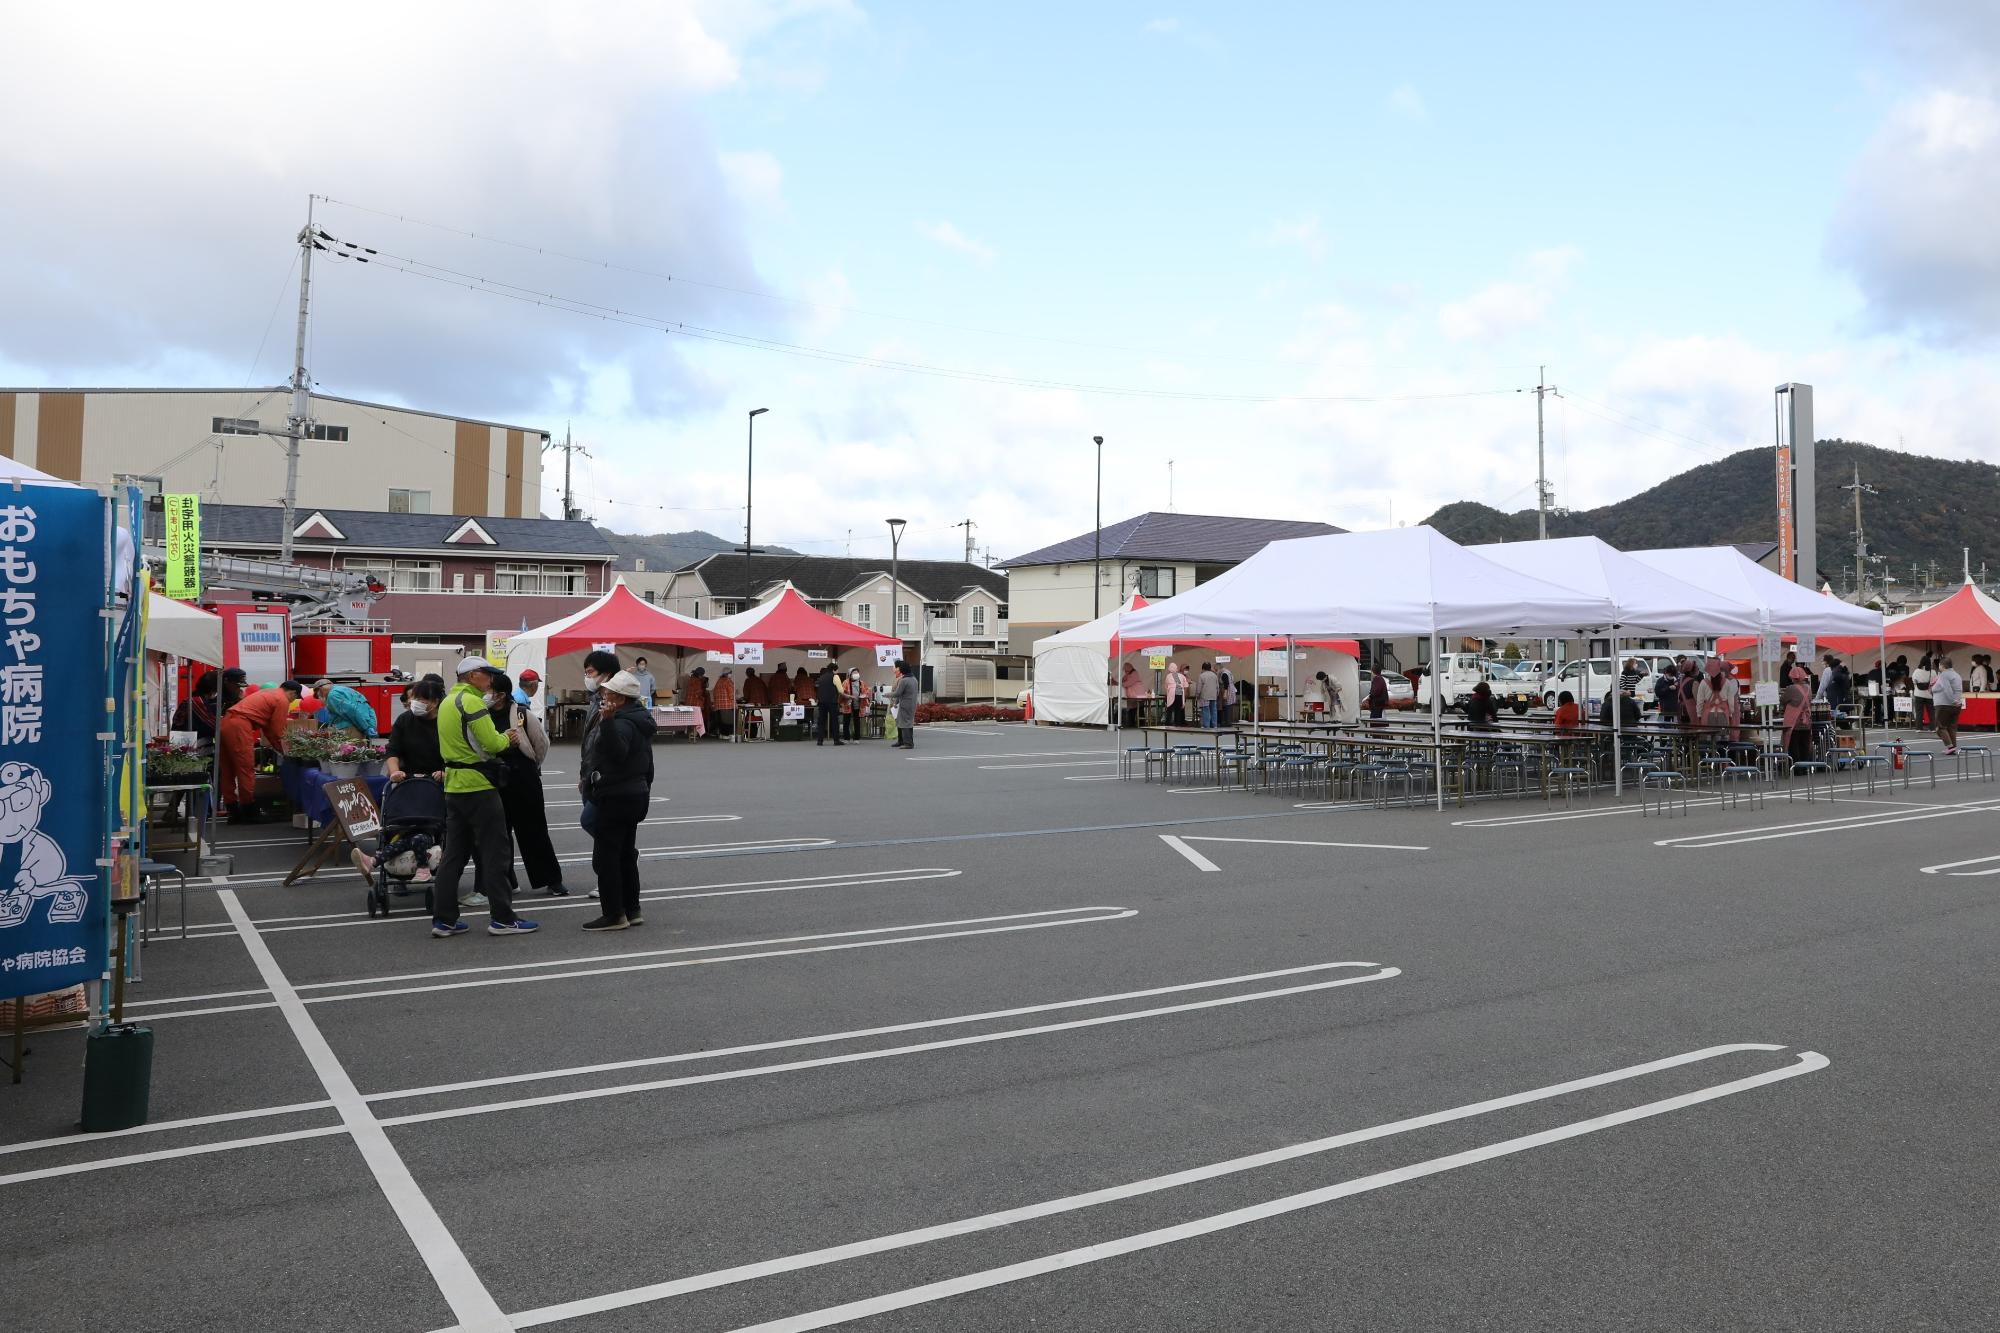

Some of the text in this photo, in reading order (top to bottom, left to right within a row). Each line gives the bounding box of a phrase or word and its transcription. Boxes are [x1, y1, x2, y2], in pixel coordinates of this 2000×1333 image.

[0, 504, 43, 746] おもちゃ病院
[0, 946, 87, 972] ゃ病院協会
